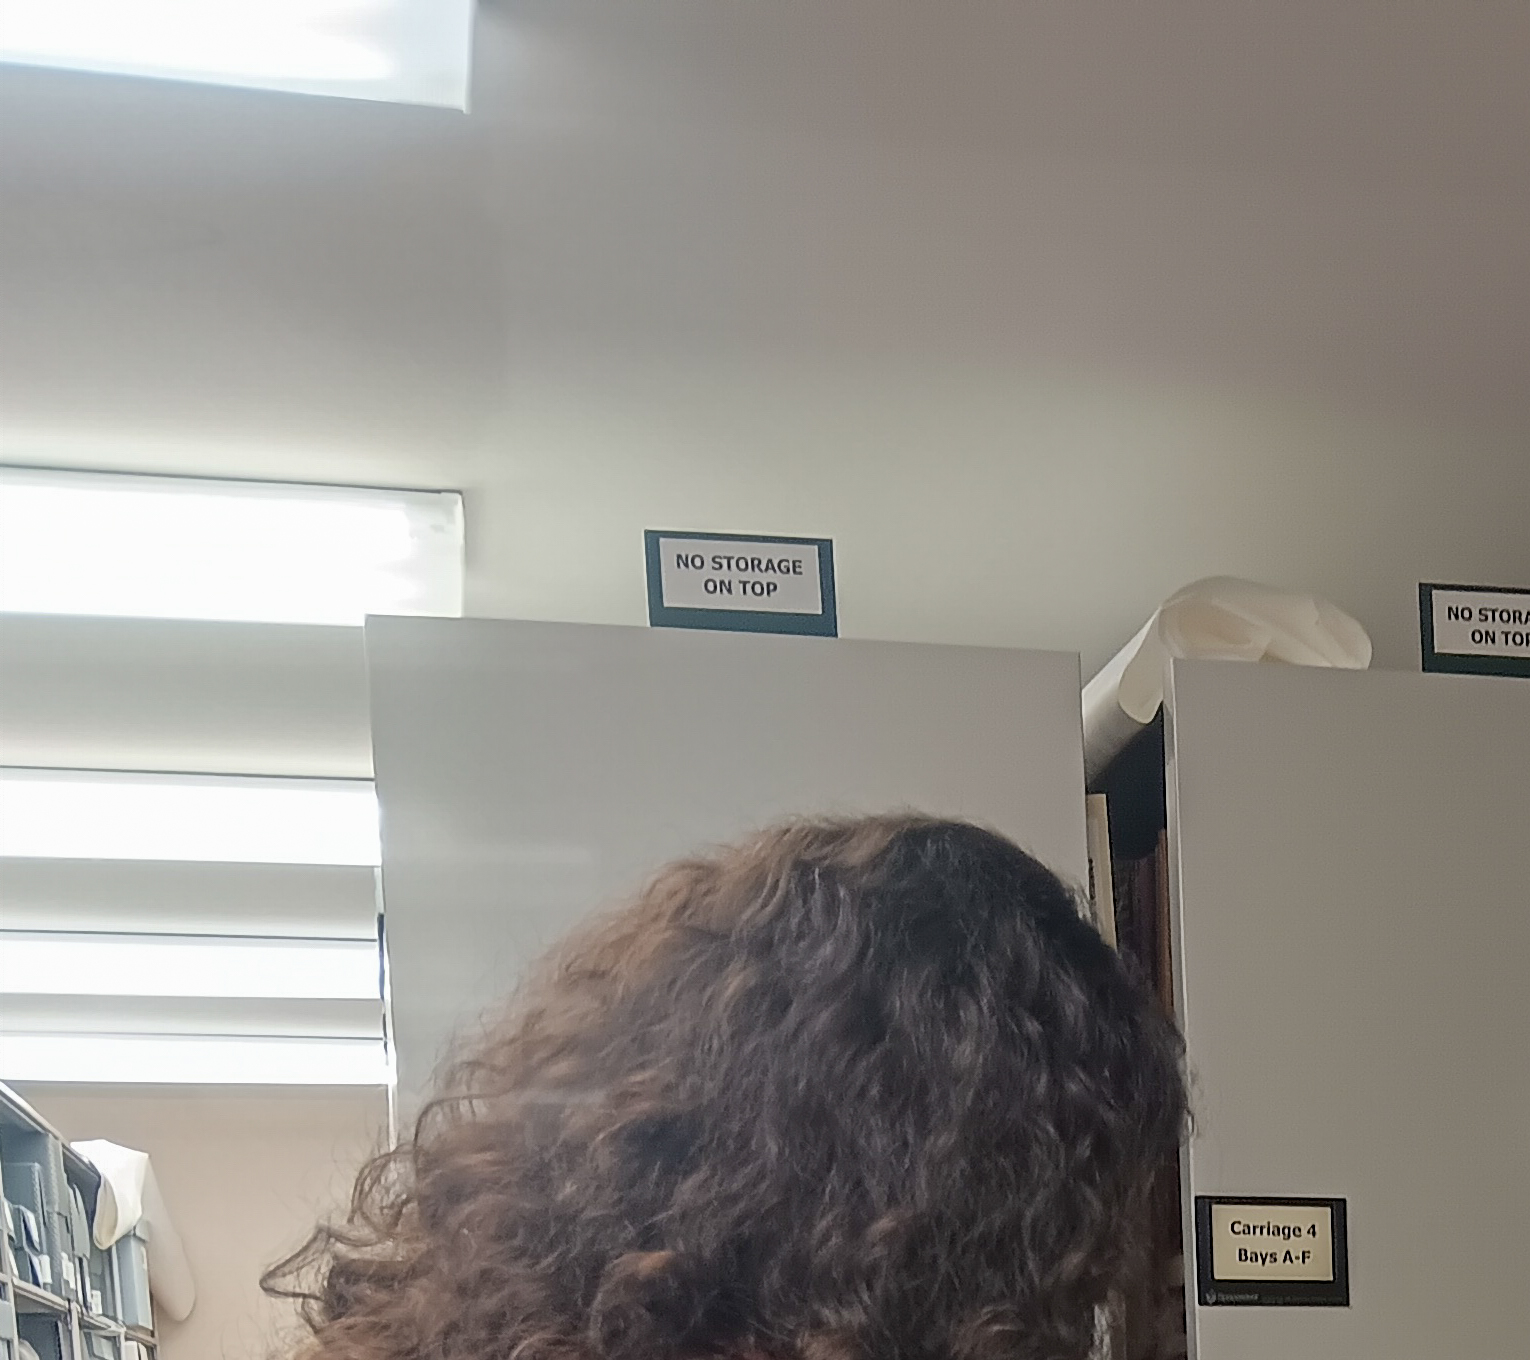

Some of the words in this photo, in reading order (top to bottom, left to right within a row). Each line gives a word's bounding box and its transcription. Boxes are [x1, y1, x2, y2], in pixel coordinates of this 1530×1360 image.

[676, 553, 705, 570] NO
[711, 554, 803, 576] STORAGE
[704, 578, 733, 595] ON
[738, 580, 778, 597] TOP
[1447, 605, 1473, 622] NO
[1471, 629, 1496, 645] ON
[1230, 1220, 1302, 1240] Carriage
[1306, 1223, 1317, 1238] 4
[1238, 1248, 1278, 1267] Bays
[1282, 1250, 1311, 1265] A-F
